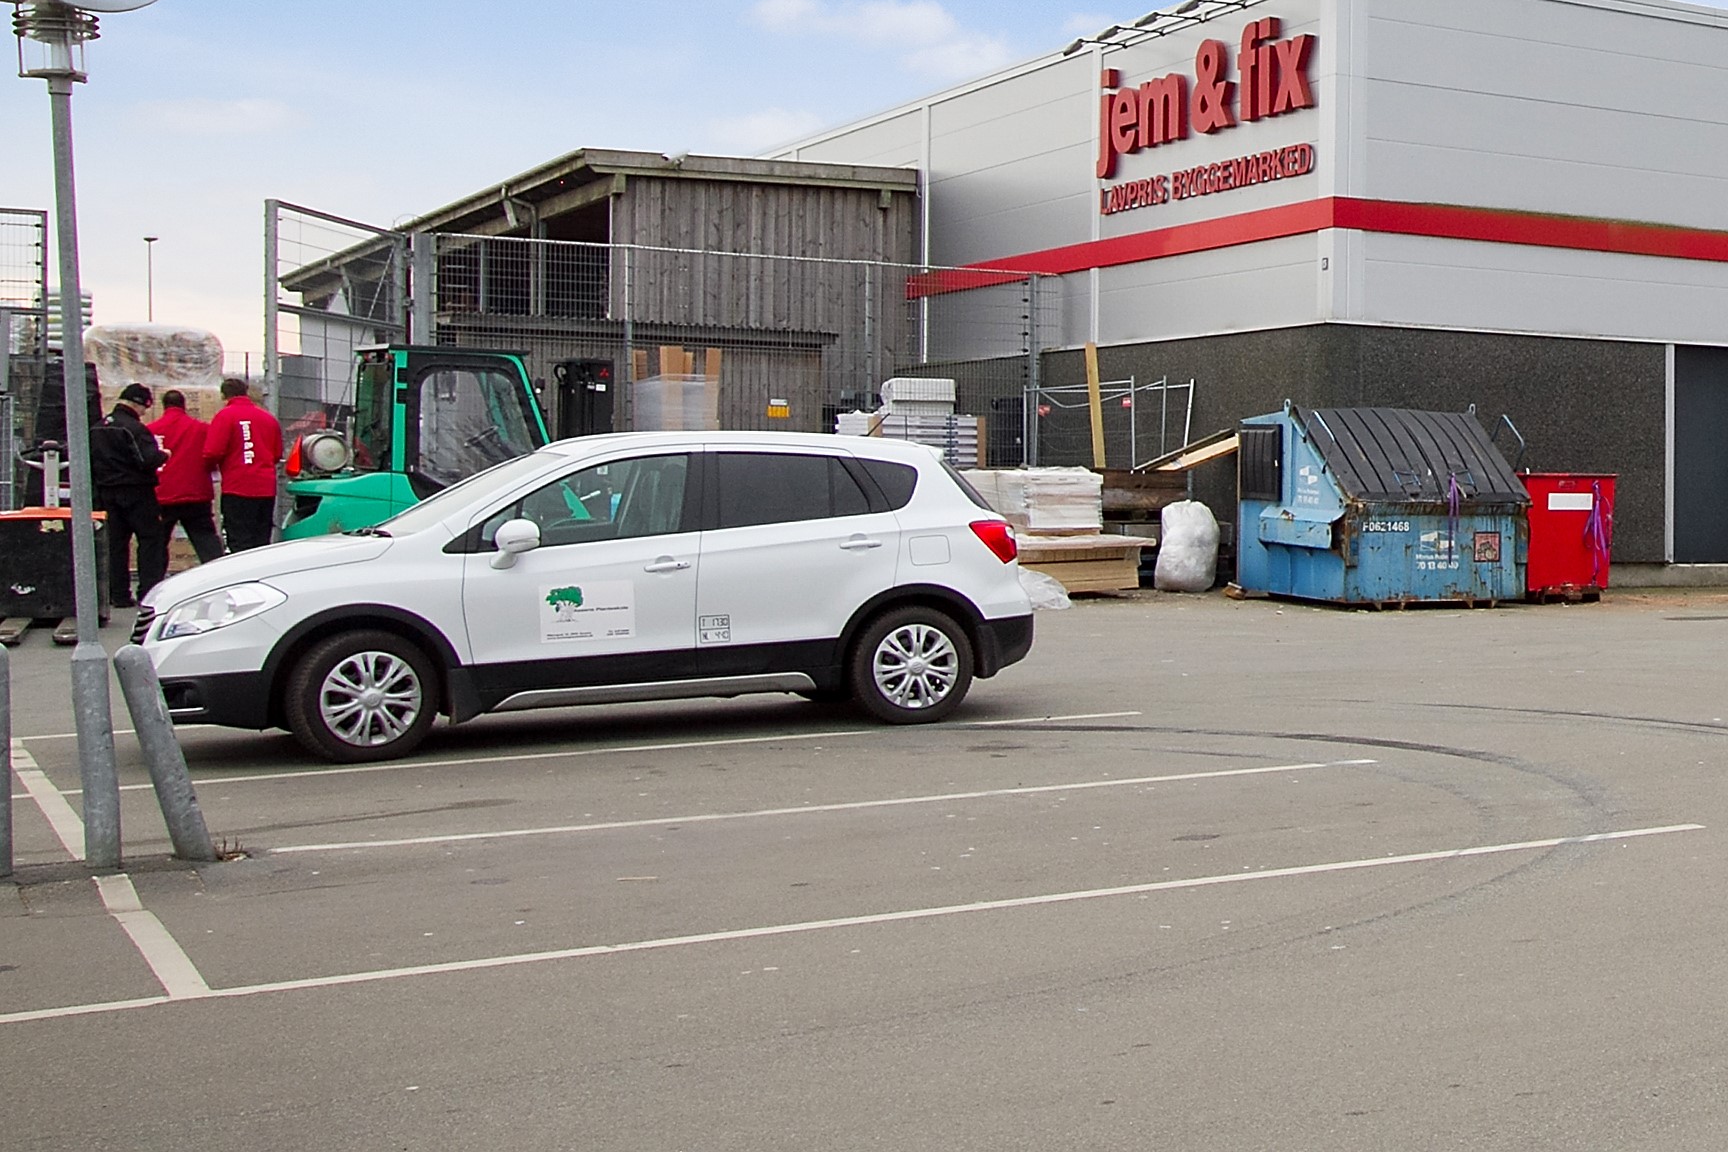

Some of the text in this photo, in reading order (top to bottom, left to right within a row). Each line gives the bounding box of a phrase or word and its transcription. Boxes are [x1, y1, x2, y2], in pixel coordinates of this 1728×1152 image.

[1097, 17, 1316, 179] jem & fix
[1100, 143, 1315, 215] LAVPRIS BYGGEMARKED
[239, 420, 251, 441] jem
[244, 451, 255, 465] fix
[1363, 521, 1410, 532] F0621468
